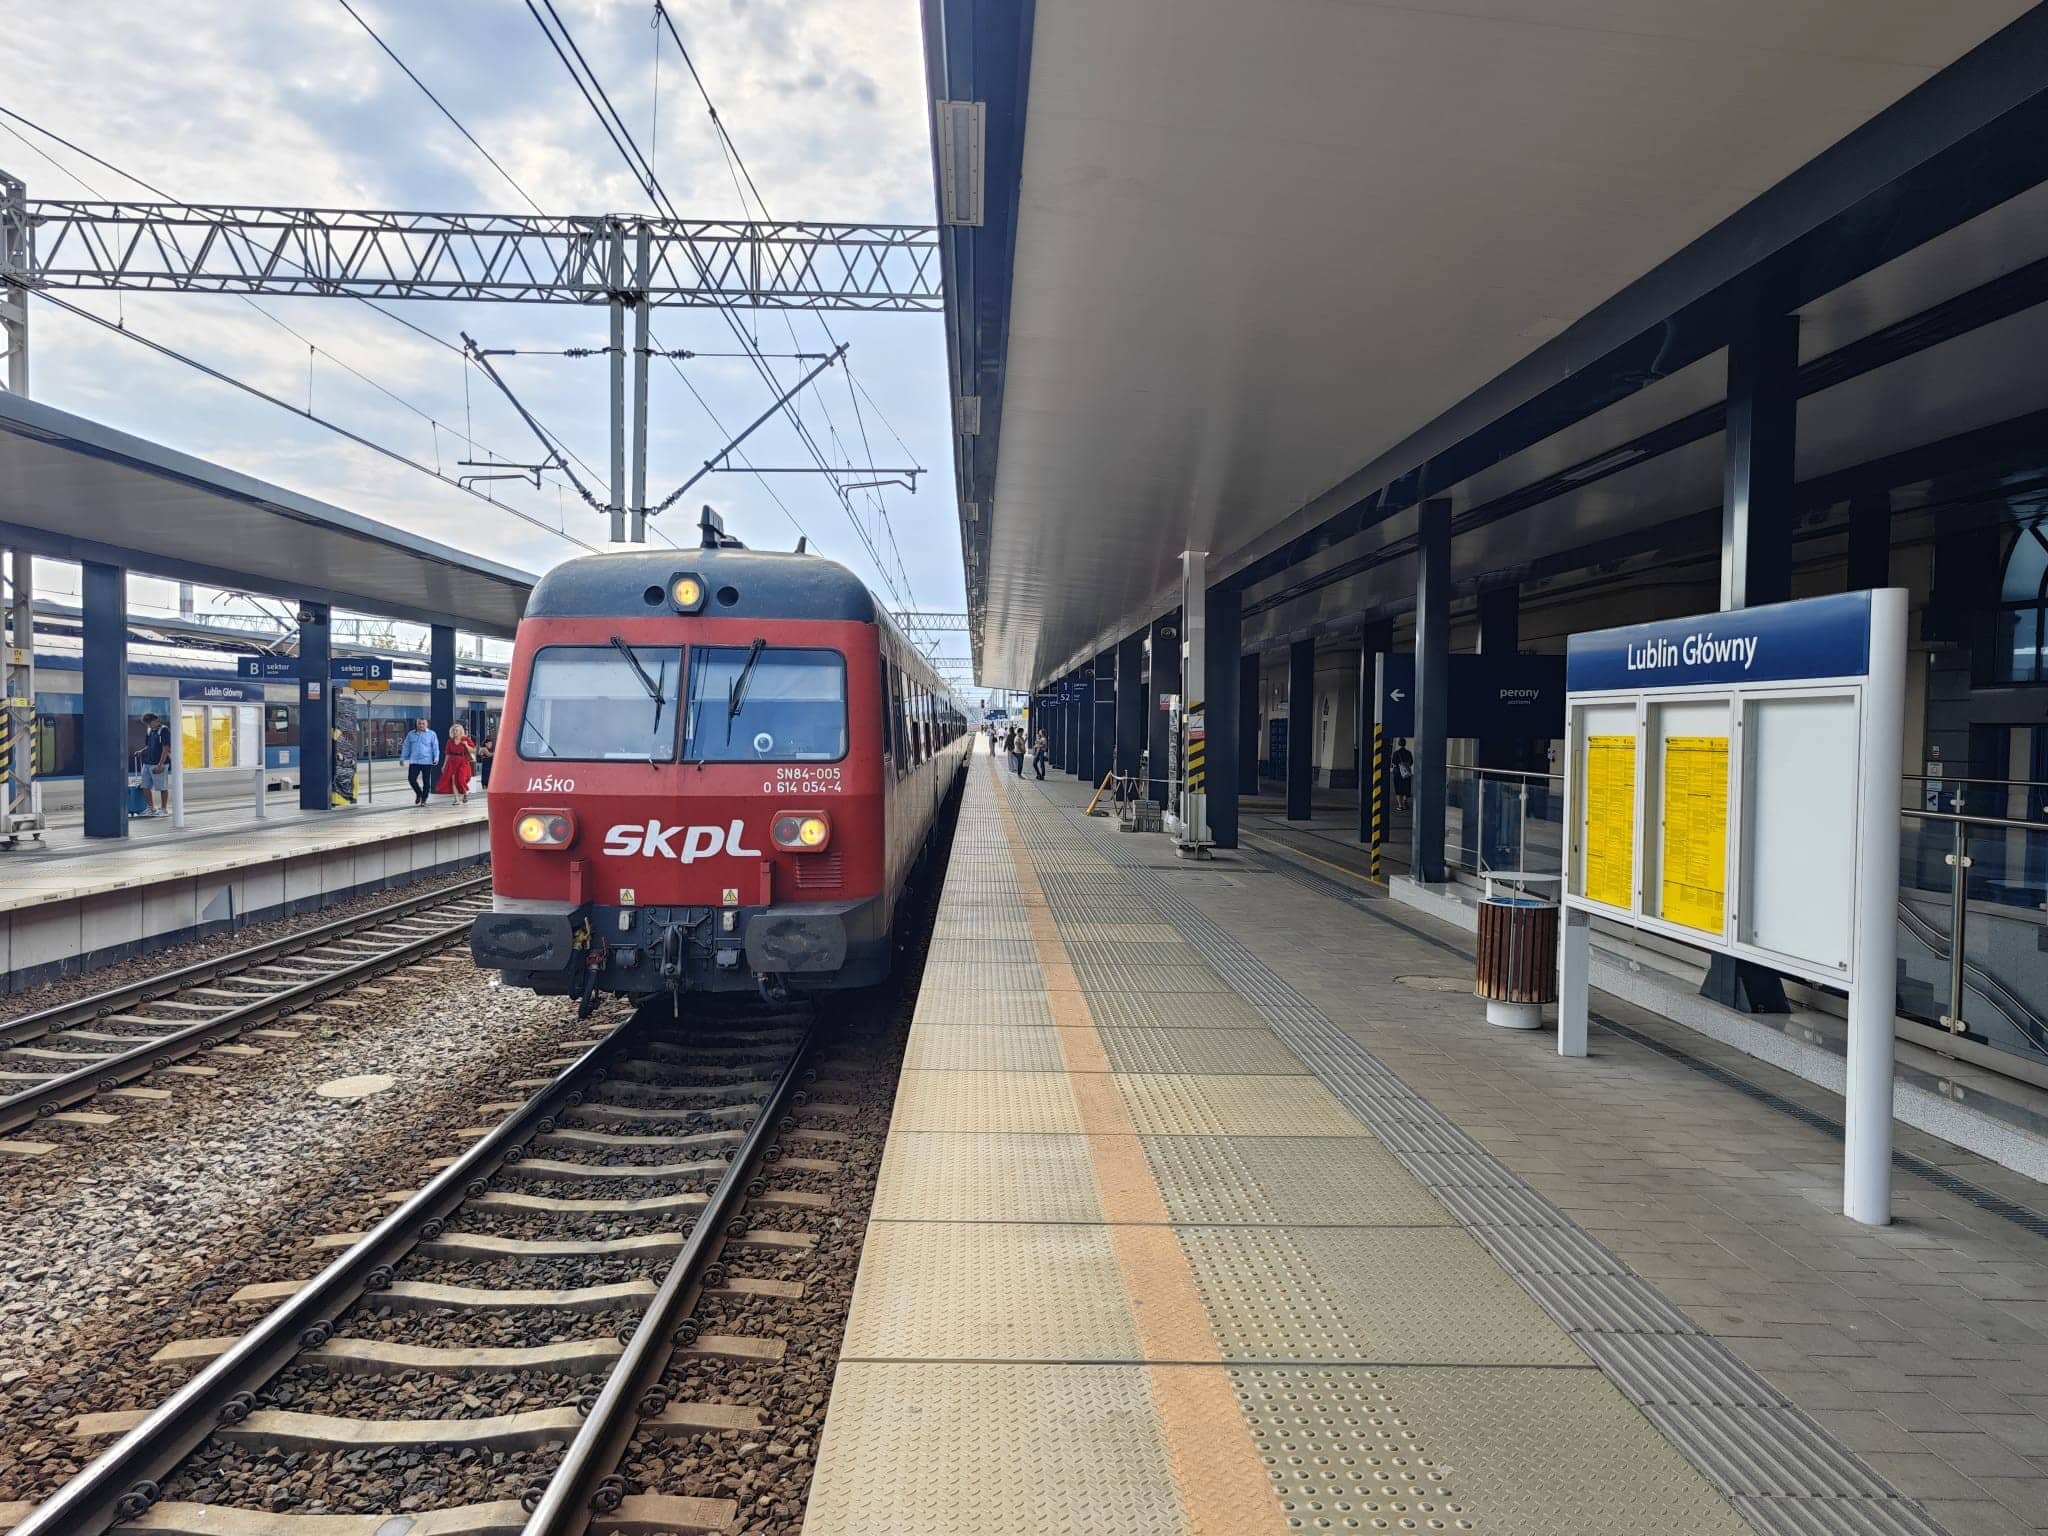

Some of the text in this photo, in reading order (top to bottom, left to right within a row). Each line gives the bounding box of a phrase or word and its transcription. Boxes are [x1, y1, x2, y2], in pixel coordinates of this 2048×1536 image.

[1627, 632, 1758, 670] Lublin Główny
[250, 662, 290, 675] B sektor
[341, 664, 381, 677] sektor B
[204, 687, 243, 698] Lublin Główny
[1500, 689, 1540, 700] perony
[777, 768, 841, 780] SN84-005
[526, 774, 575, 793] JAŚKO
[777, 781, 798, 793] 614
[802, 781, 842, 793] 054-4
